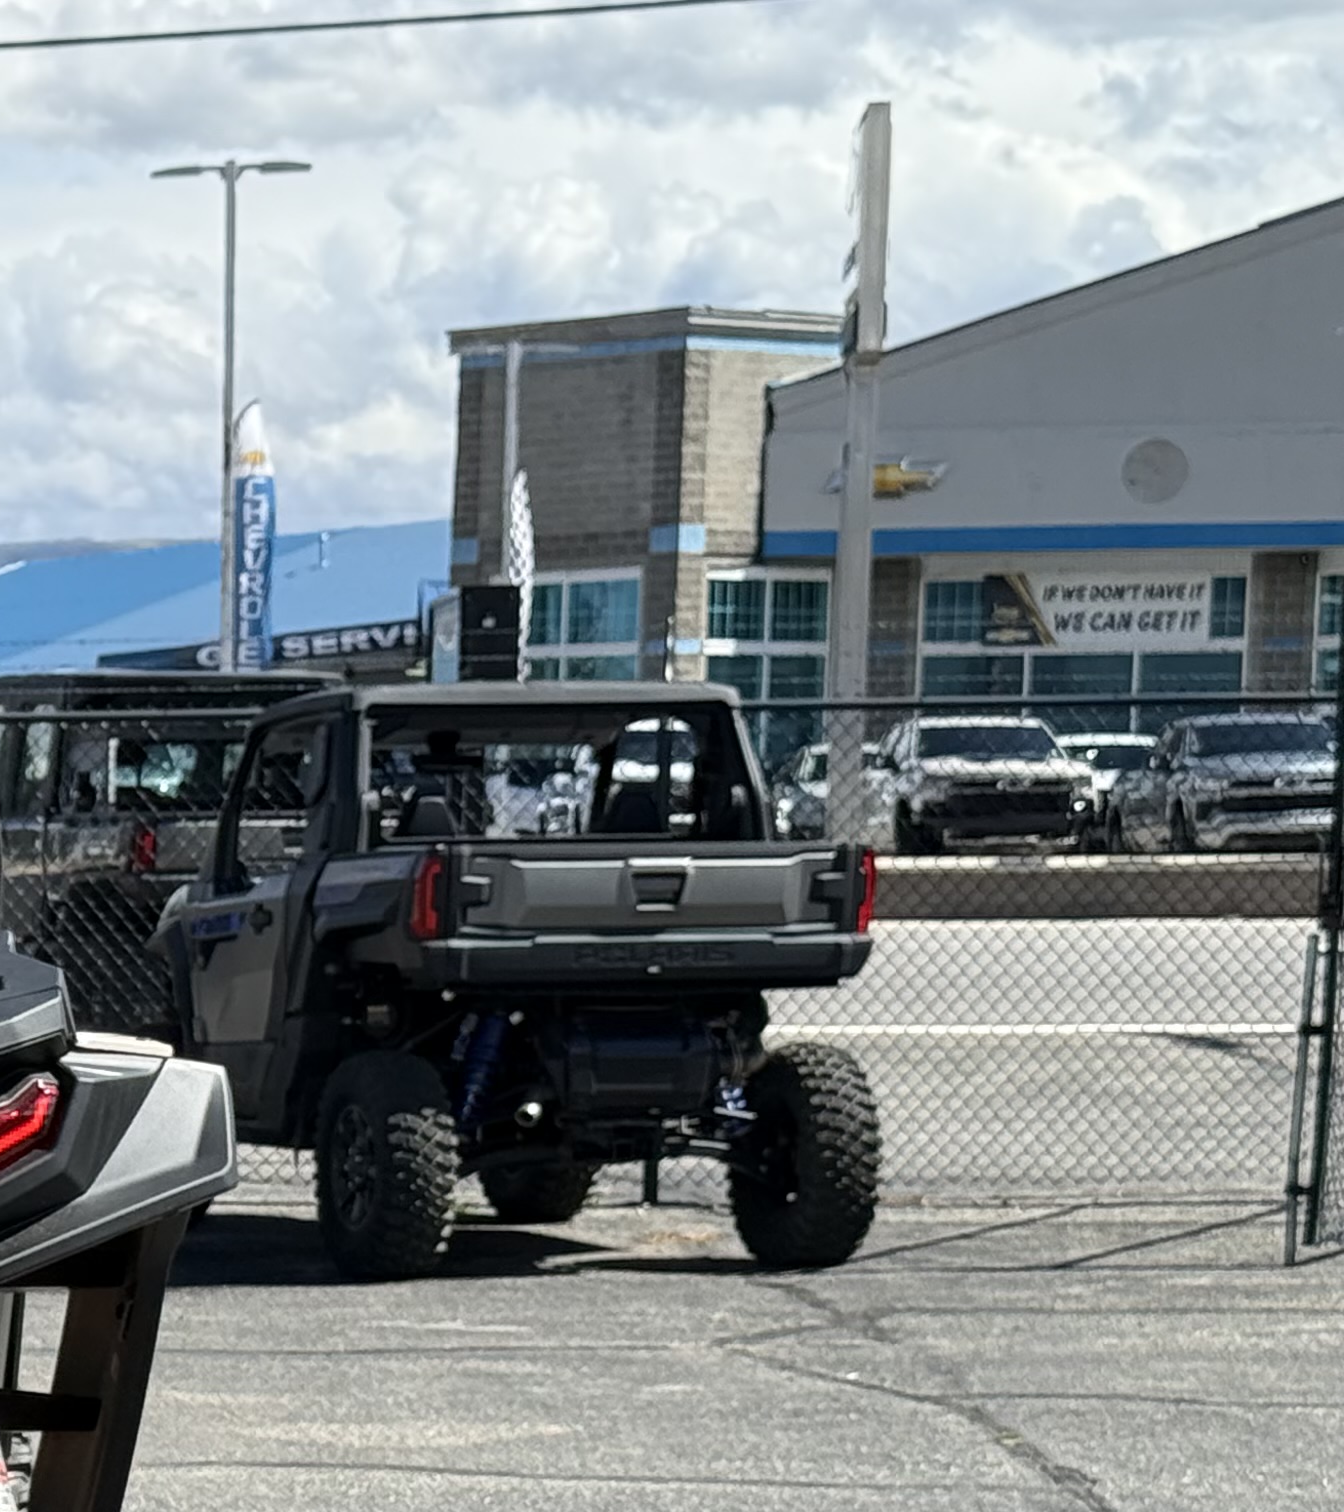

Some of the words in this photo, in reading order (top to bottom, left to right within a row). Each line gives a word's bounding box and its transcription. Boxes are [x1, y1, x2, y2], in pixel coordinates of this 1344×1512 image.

[238, 477, 270, 671] CHEVROLE
[1043, 583, 1060, 601] IF
[1062, 583, 1089, 601] WE
[1089, 583, 1141, 601] DON'T
[1143, 582, 1186, 600] HAVE
[1189, 582, 1206, 600] IT
[1054, 611, 1086, 634] WE
[1089, 610, 1133, 633] CAN
[1138, 610, 1179, 633] GET
[1179, 610, 1201, 633] IT
[281, 623, 418, 659] SERVI
